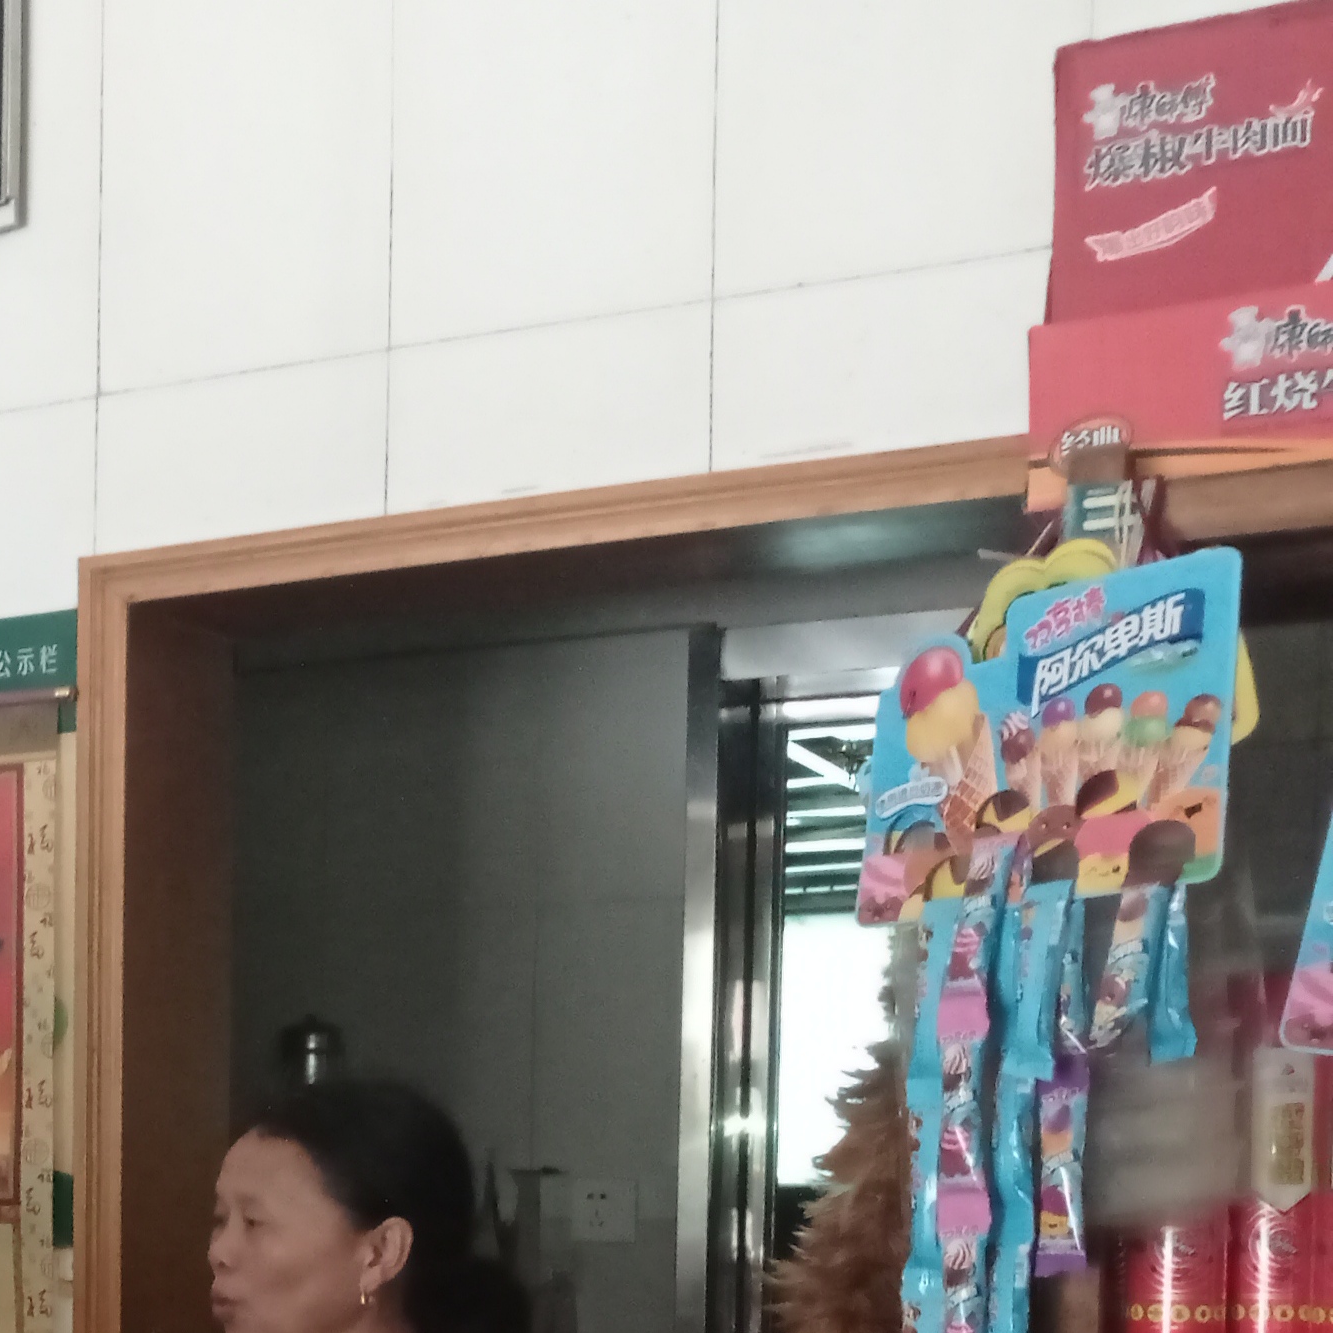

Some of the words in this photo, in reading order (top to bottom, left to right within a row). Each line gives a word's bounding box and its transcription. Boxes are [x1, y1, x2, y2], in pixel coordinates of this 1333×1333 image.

[1085, 108, 1314, 190] 爆椒牛肉面
